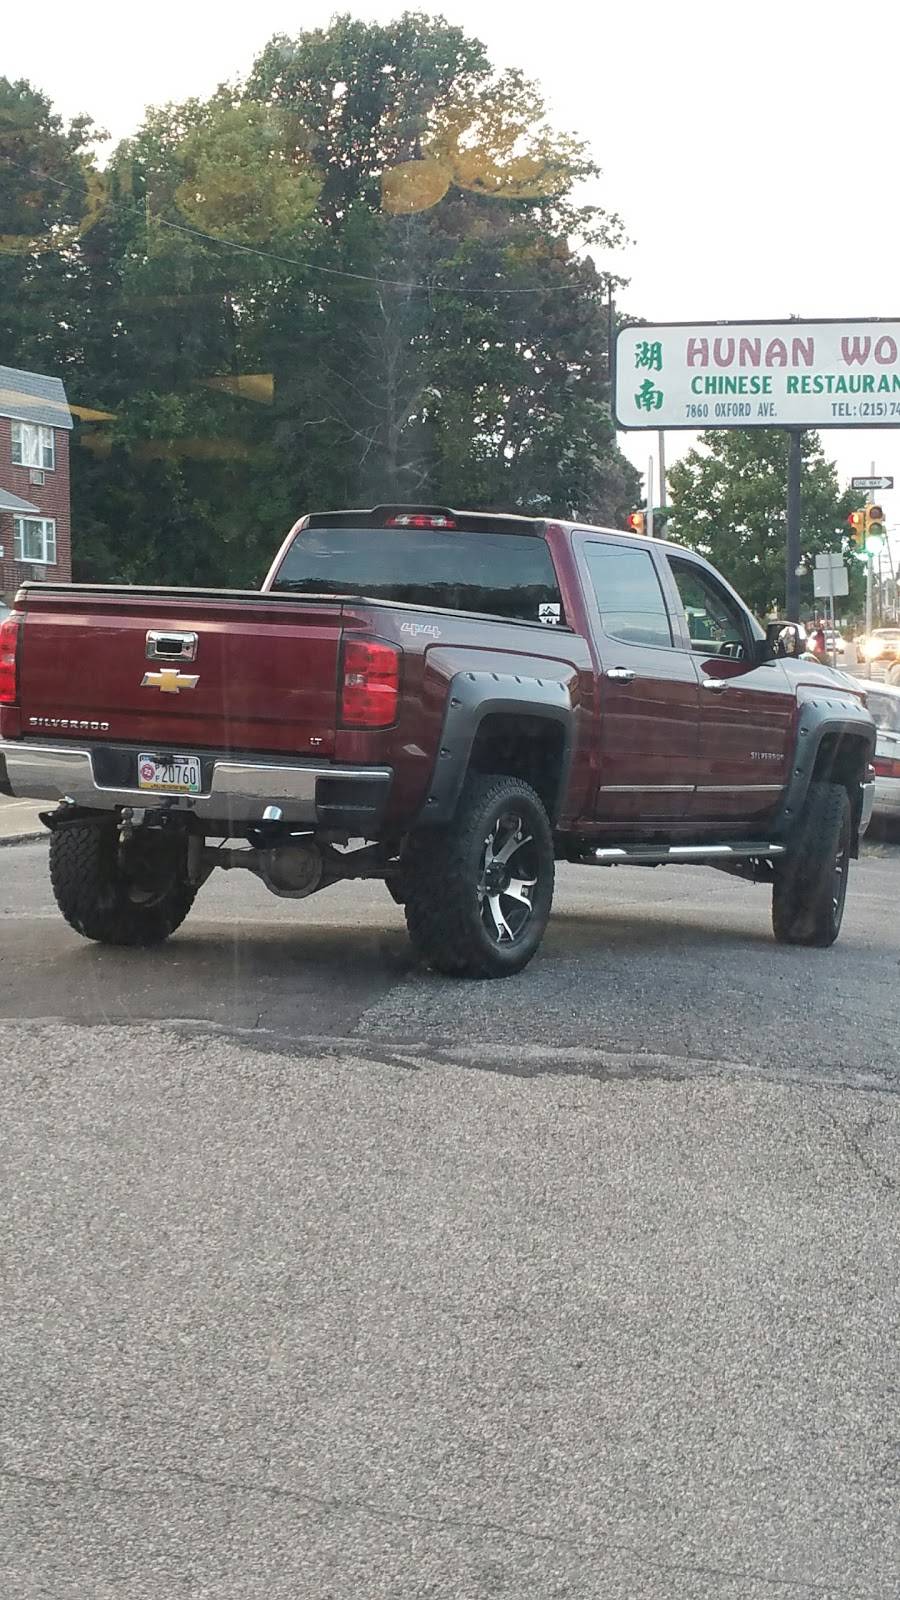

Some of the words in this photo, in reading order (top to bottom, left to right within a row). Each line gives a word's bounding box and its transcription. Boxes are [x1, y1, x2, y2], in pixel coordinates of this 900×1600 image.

[686, 336, 815, 368] HUNAN
[841, 335, 898, 366] WO
[634, 340, 664, 412] 湖南
[691, 375, 773, 395] CHINESE
[686, 404, 708, 418] 7860
[715, 403, 751, 417] OXFORD
[757, 402, 777, 416] AVE.
[29, 717, 109, 731] SILVERADO
[161, 764, 197, 785] 20760
